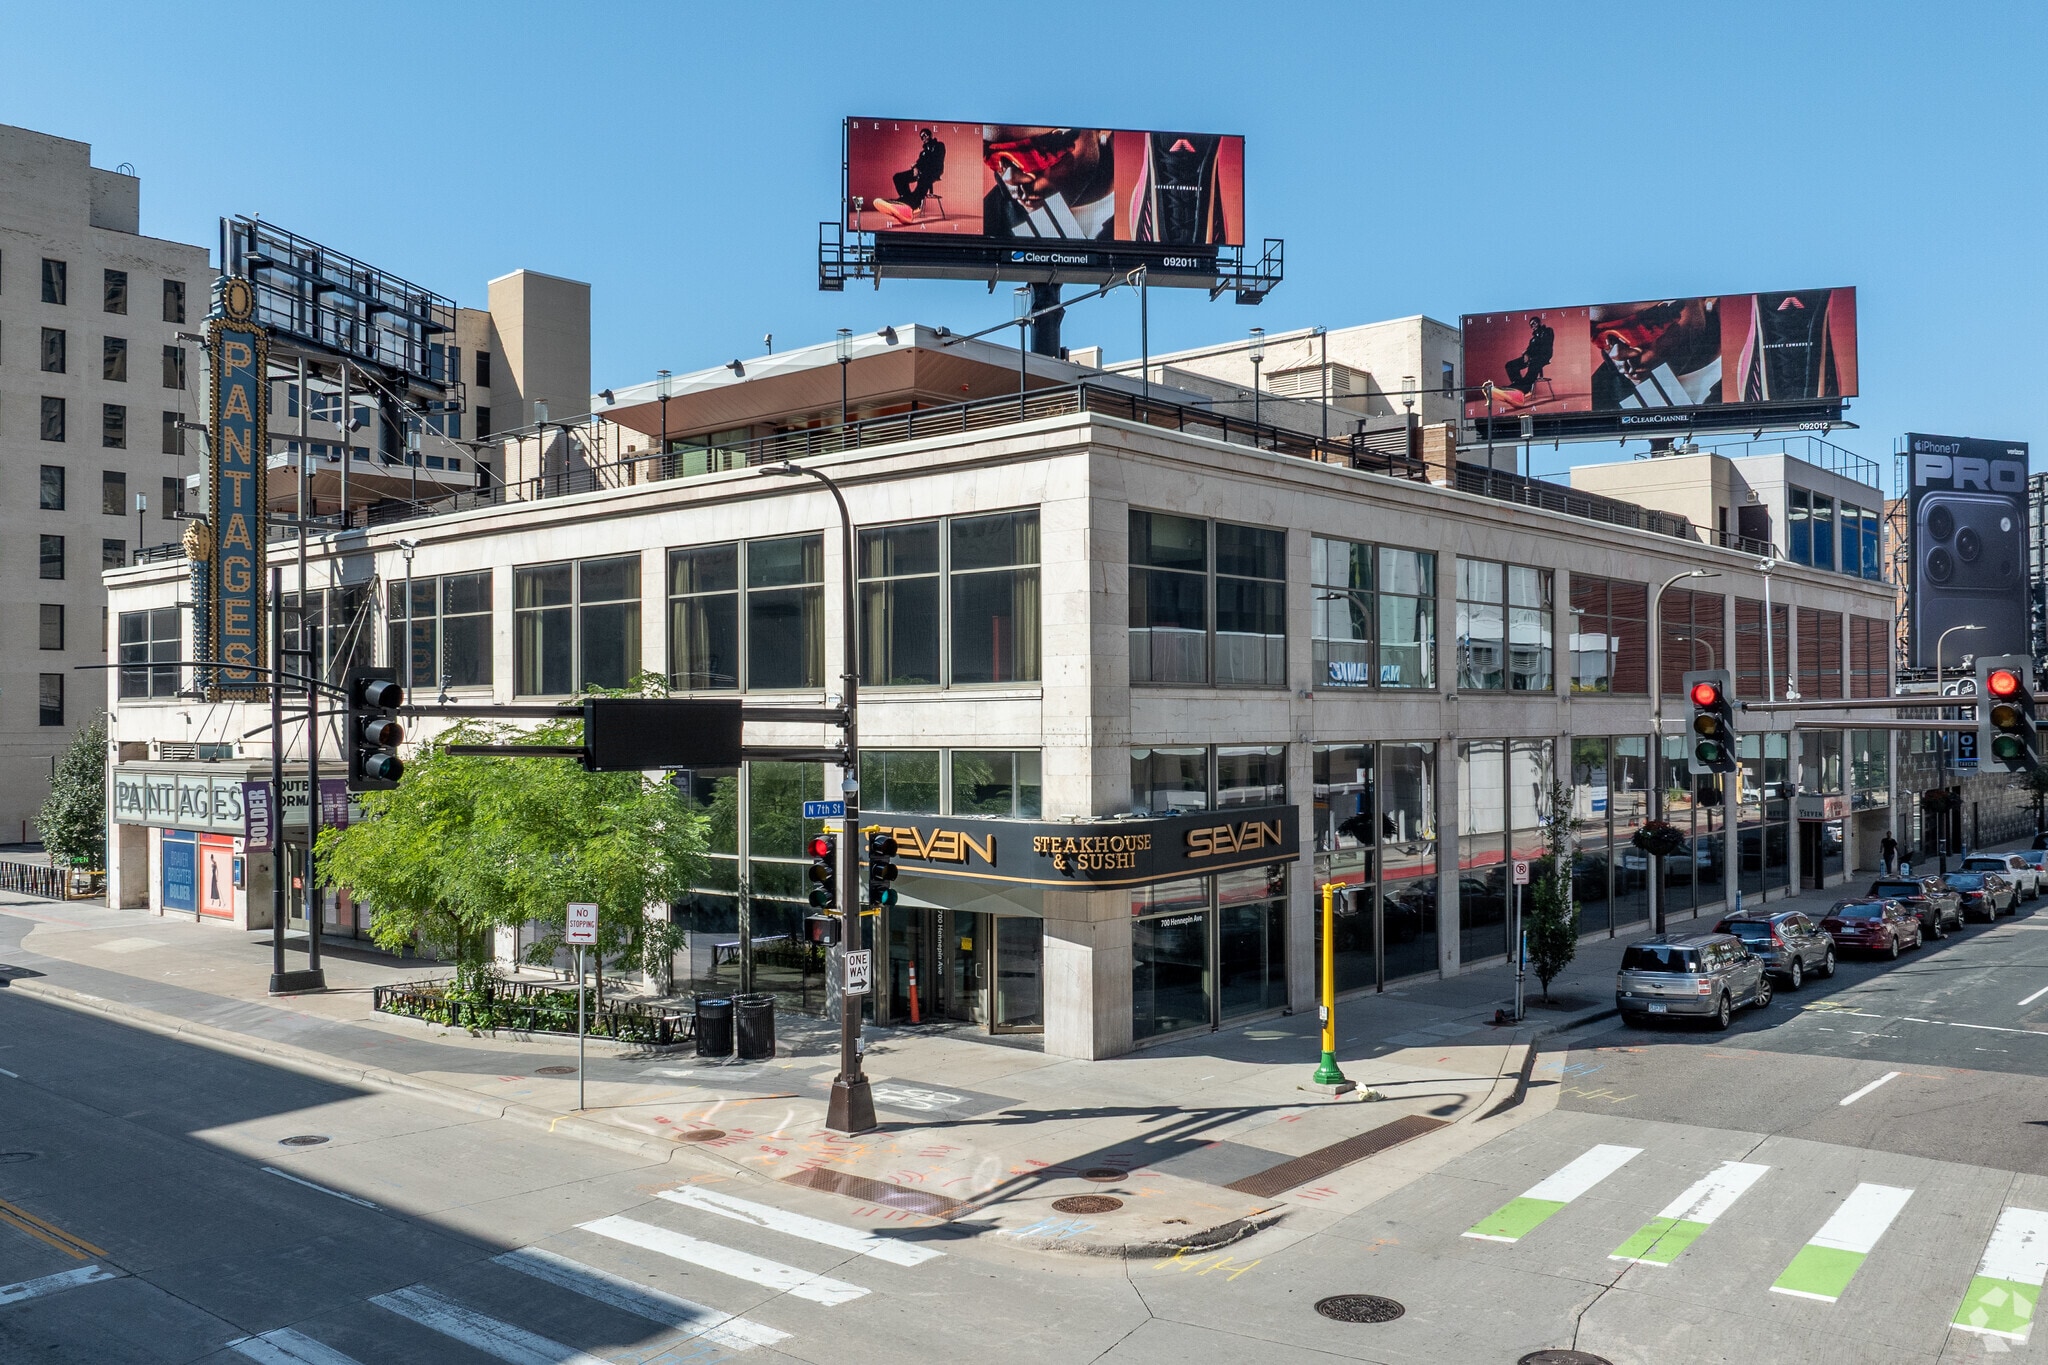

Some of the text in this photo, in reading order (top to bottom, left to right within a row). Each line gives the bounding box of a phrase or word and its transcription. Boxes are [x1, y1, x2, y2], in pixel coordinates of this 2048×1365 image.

[1025, 252, 1088, 264] Clear Channel
[1163, 257, 1197, 268] 092011
[1799, 422, 1829, 430] 092012
[1921, 440, 1960, 454] iPhone 17
[2007, 448, 2025, 456] verizon
[1915, 453, 2025, 493] PRO
[223, 340, 253, 680] PANTAGES
[1959, 703, 1975, 757] EOT
[119, 781, 241, 821] PANTAGES
[808, 803, 841, 815] N 7th St
[248, 789, 269, 847] BOLDER
[1033, 833, 1151, 853] STEAKHOUSE
[1187, 819, 1282, 858] SEVEN
[1053, 852, 1136, 870] & SUSHI
[576, 909, 589, 918] NO
[570, 920, 595, 928] STOPPING
[1161, 914, 1203, 928] 700 Hennepin Ave
[850, 954, 868, 966] ONE
[850, 966, 868, 978] WAY
